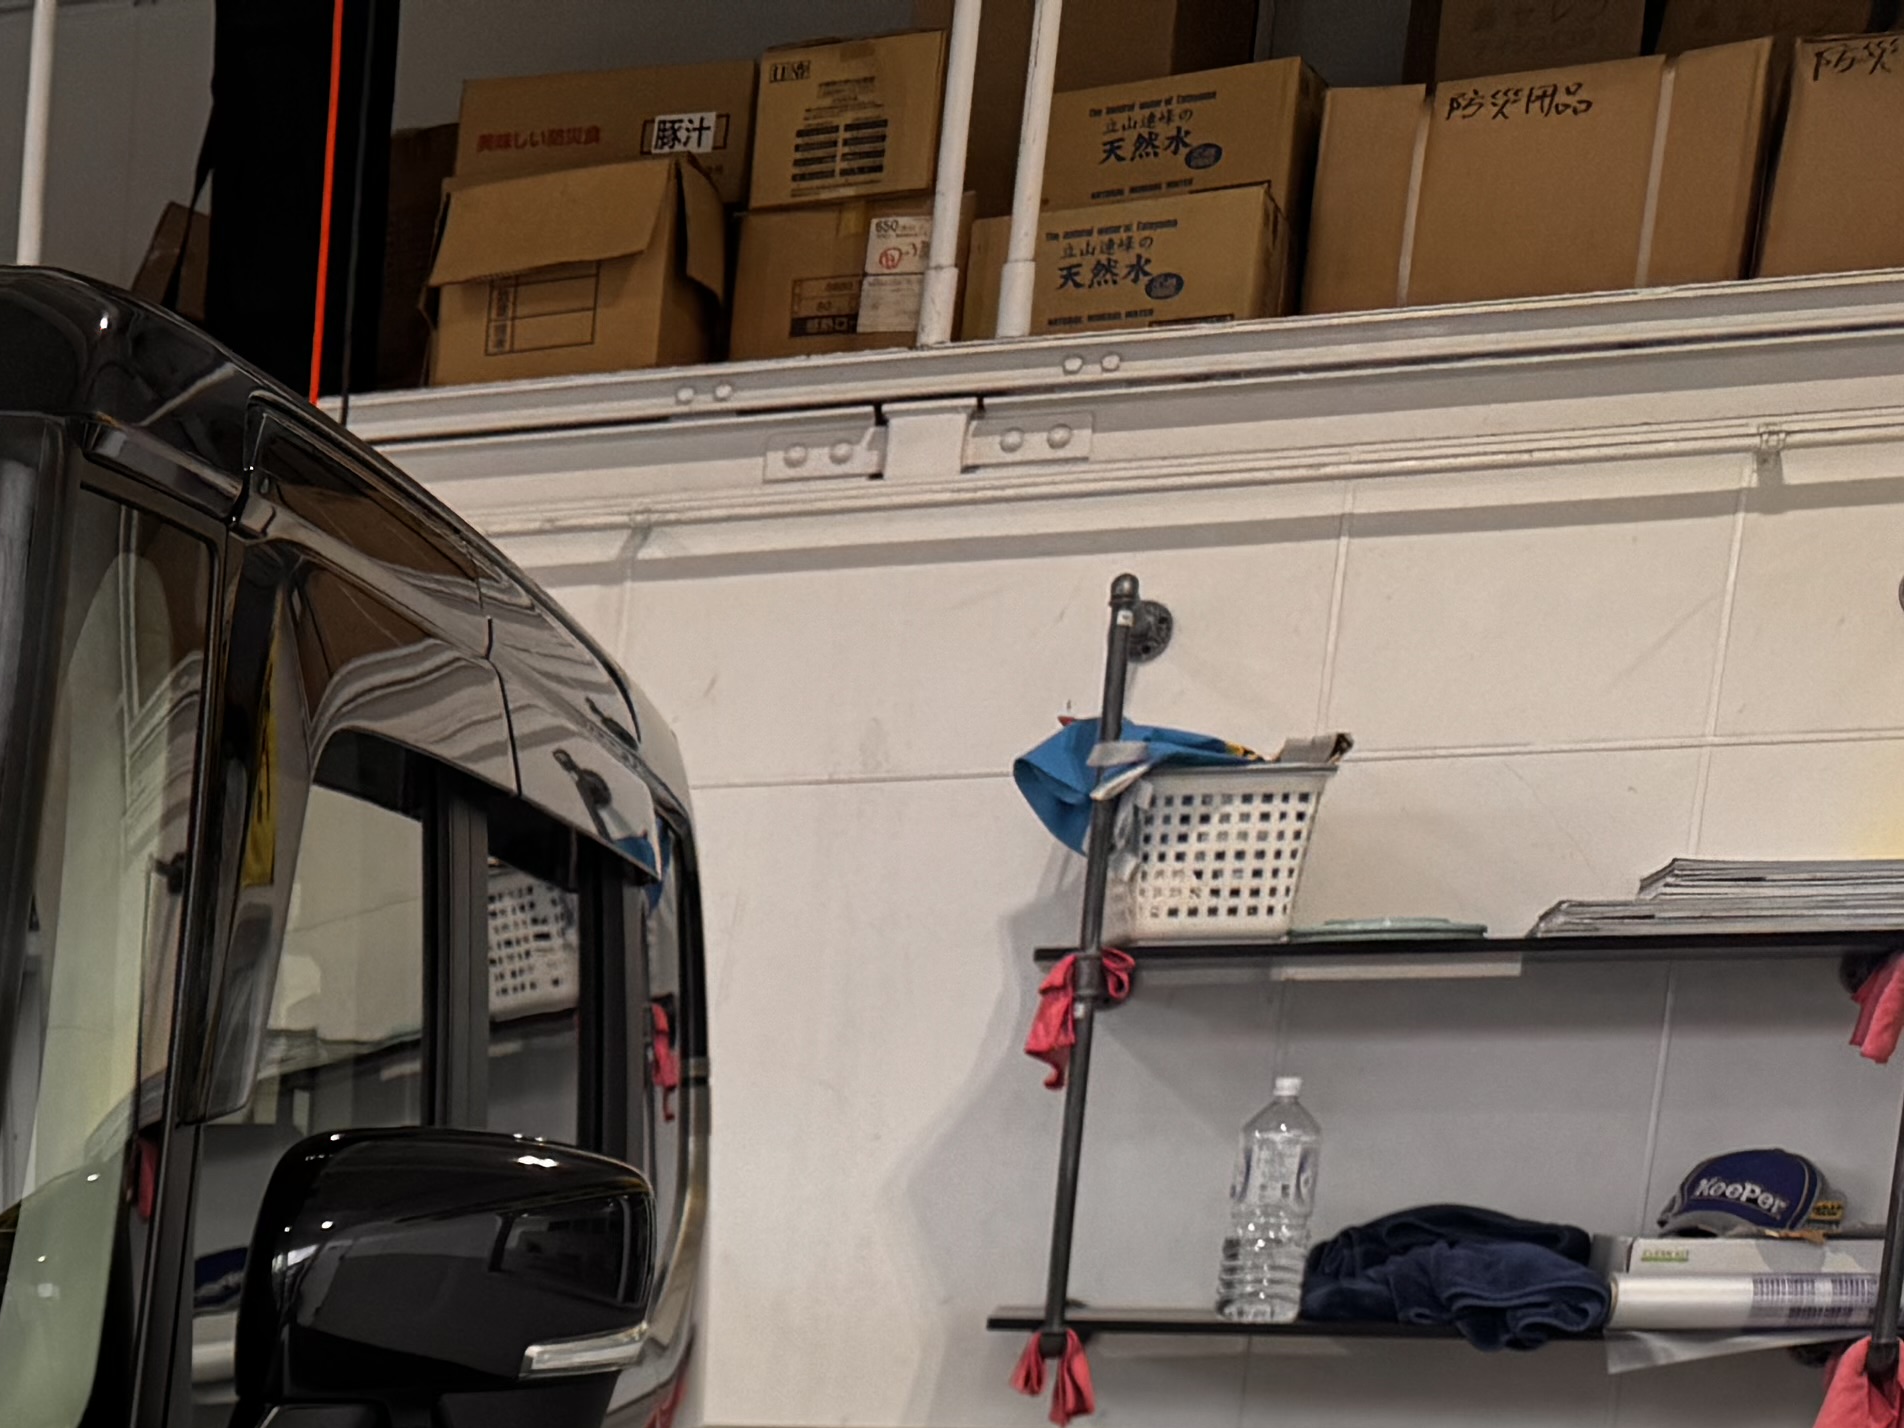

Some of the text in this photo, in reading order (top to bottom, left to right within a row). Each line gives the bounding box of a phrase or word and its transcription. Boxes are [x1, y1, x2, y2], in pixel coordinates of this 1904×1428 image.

[1447, 81, 1593, 121] 防災用品
[653, 116, 712, 150] 豚汁
[1099, 126, 1192, 165] 天然水
[1056, 254, 1152, 290] 天然水
[1694, 1176, 1789, 1220] KeePer
